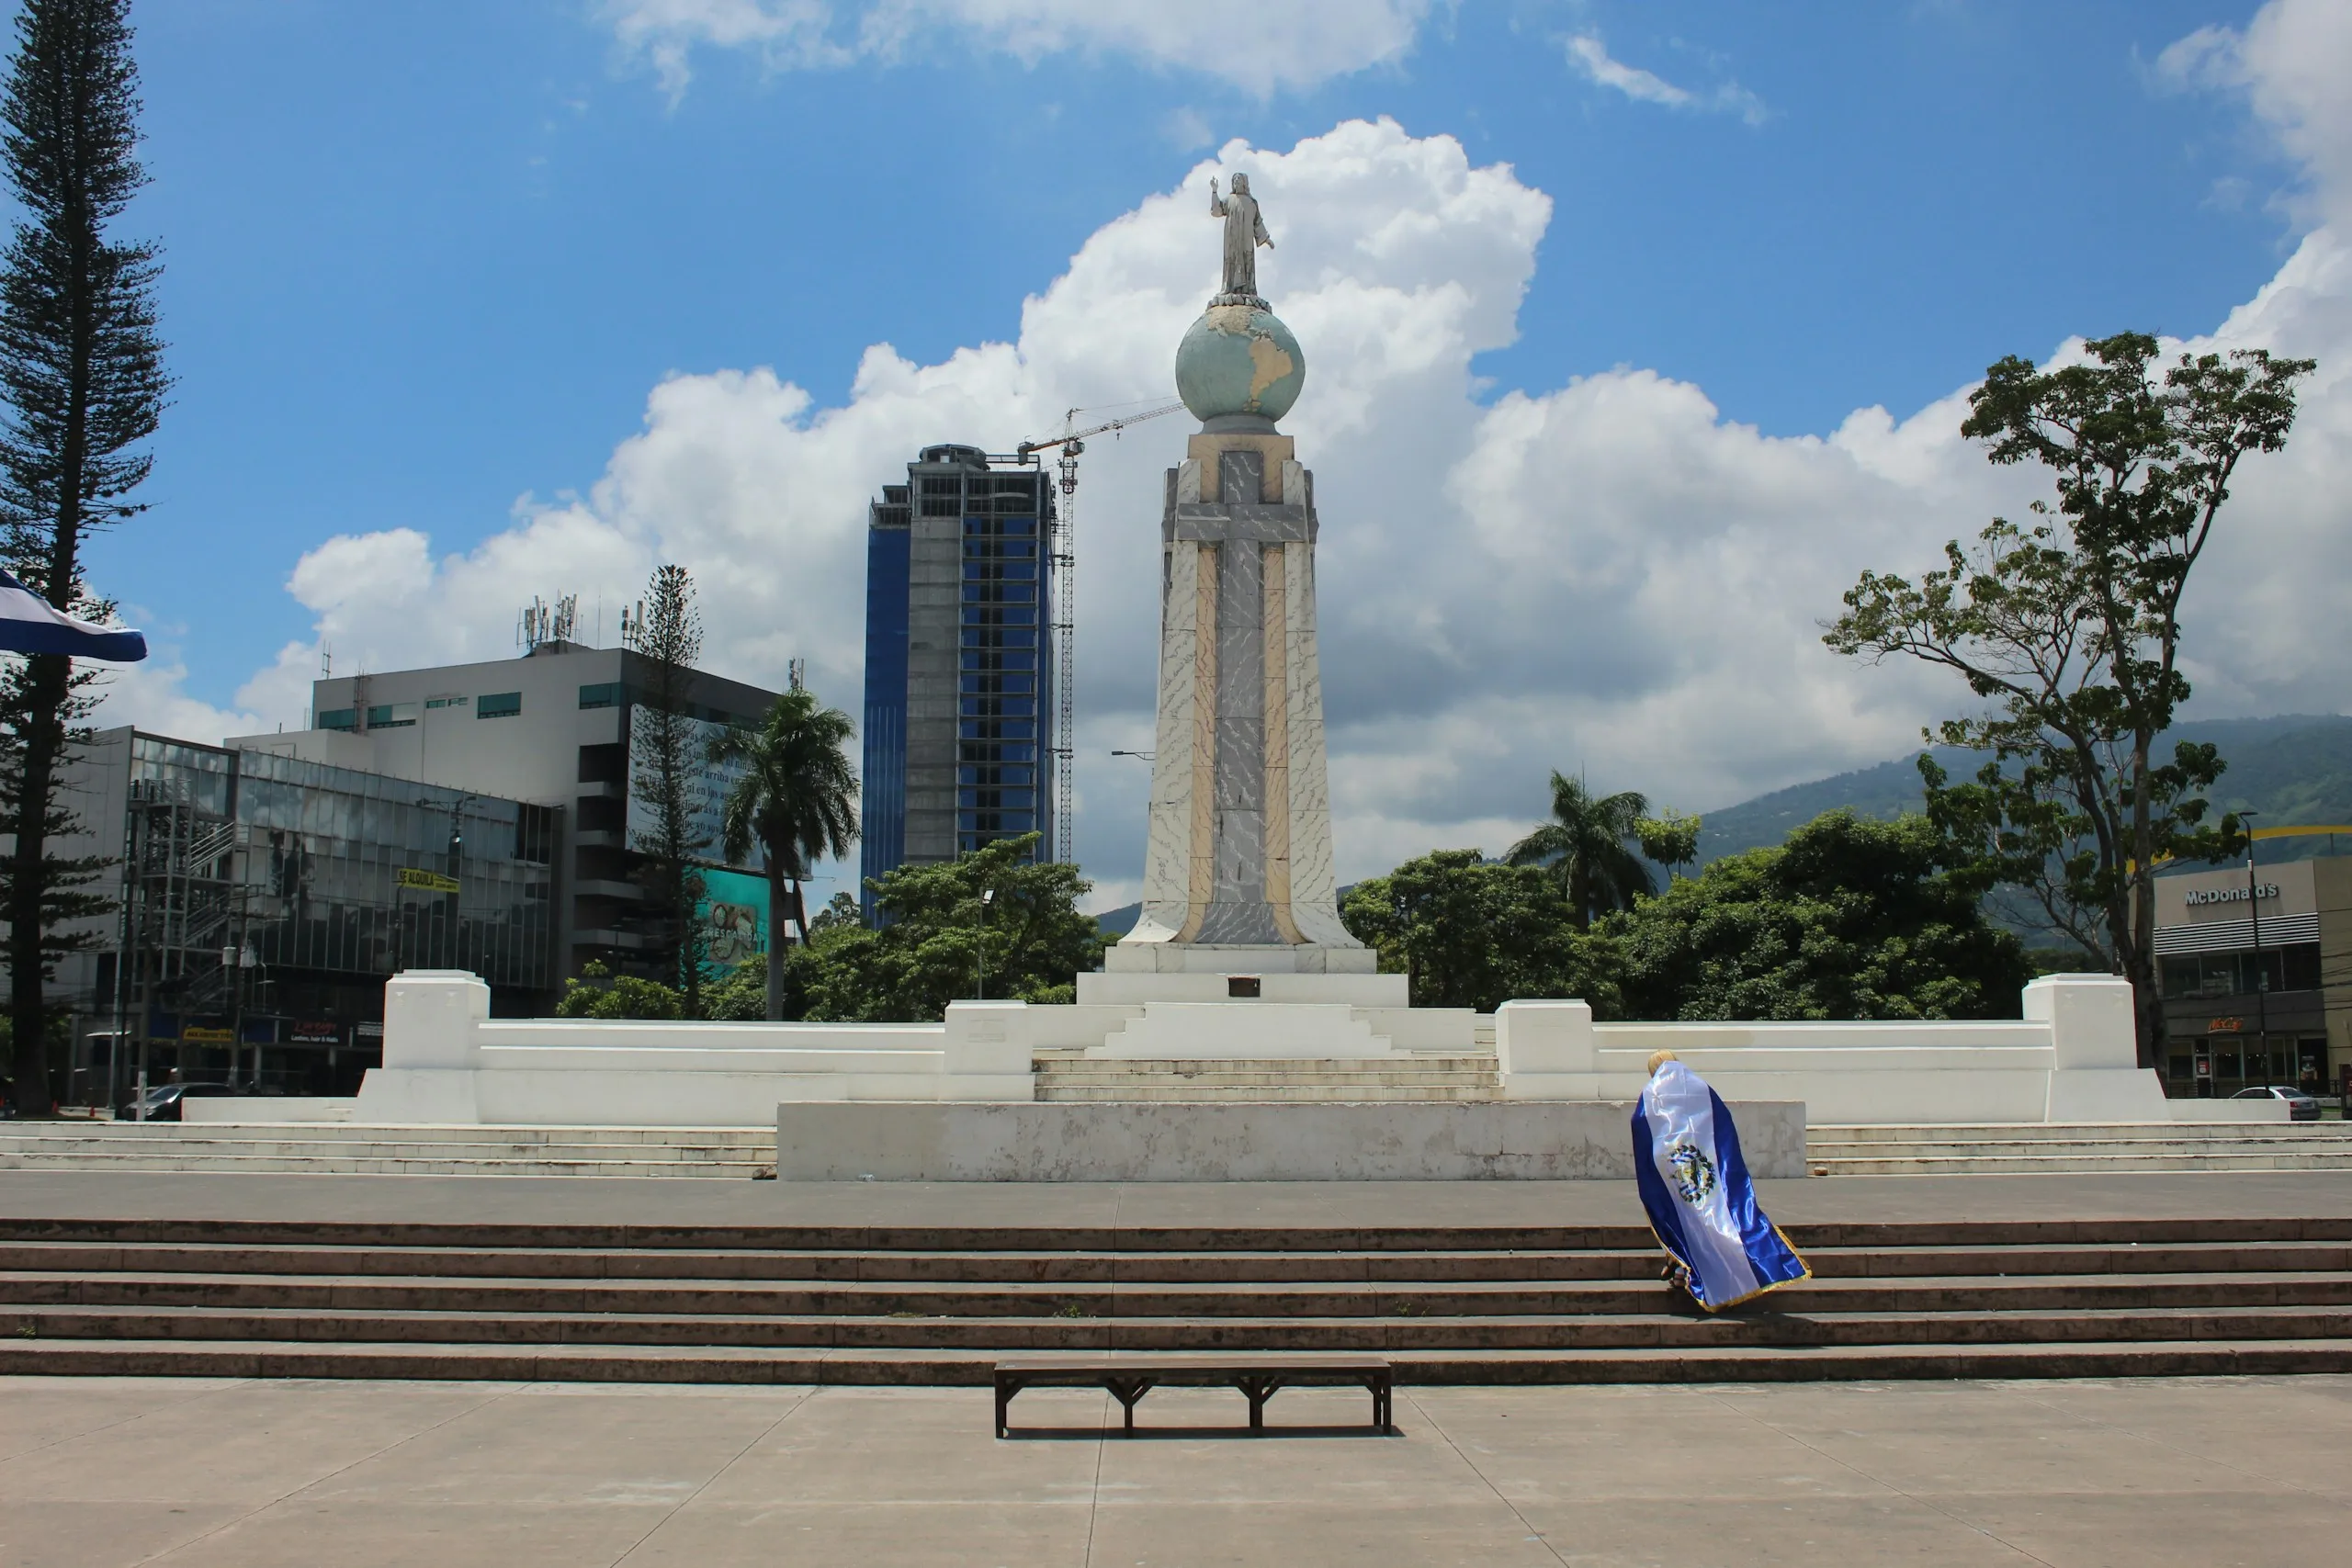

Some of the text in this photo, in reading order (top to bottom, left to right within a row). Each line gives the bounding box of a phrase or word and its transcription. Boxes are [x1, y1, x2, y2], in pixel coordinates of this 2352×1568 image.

[705, 770, 729, 784] arriba
[696, 786, 706, 796] en
[399, 870, 407, 884] SE
[408, 871, 435, 886] ALQUILA
[2186, 883, 2278, 905] McDonad's
